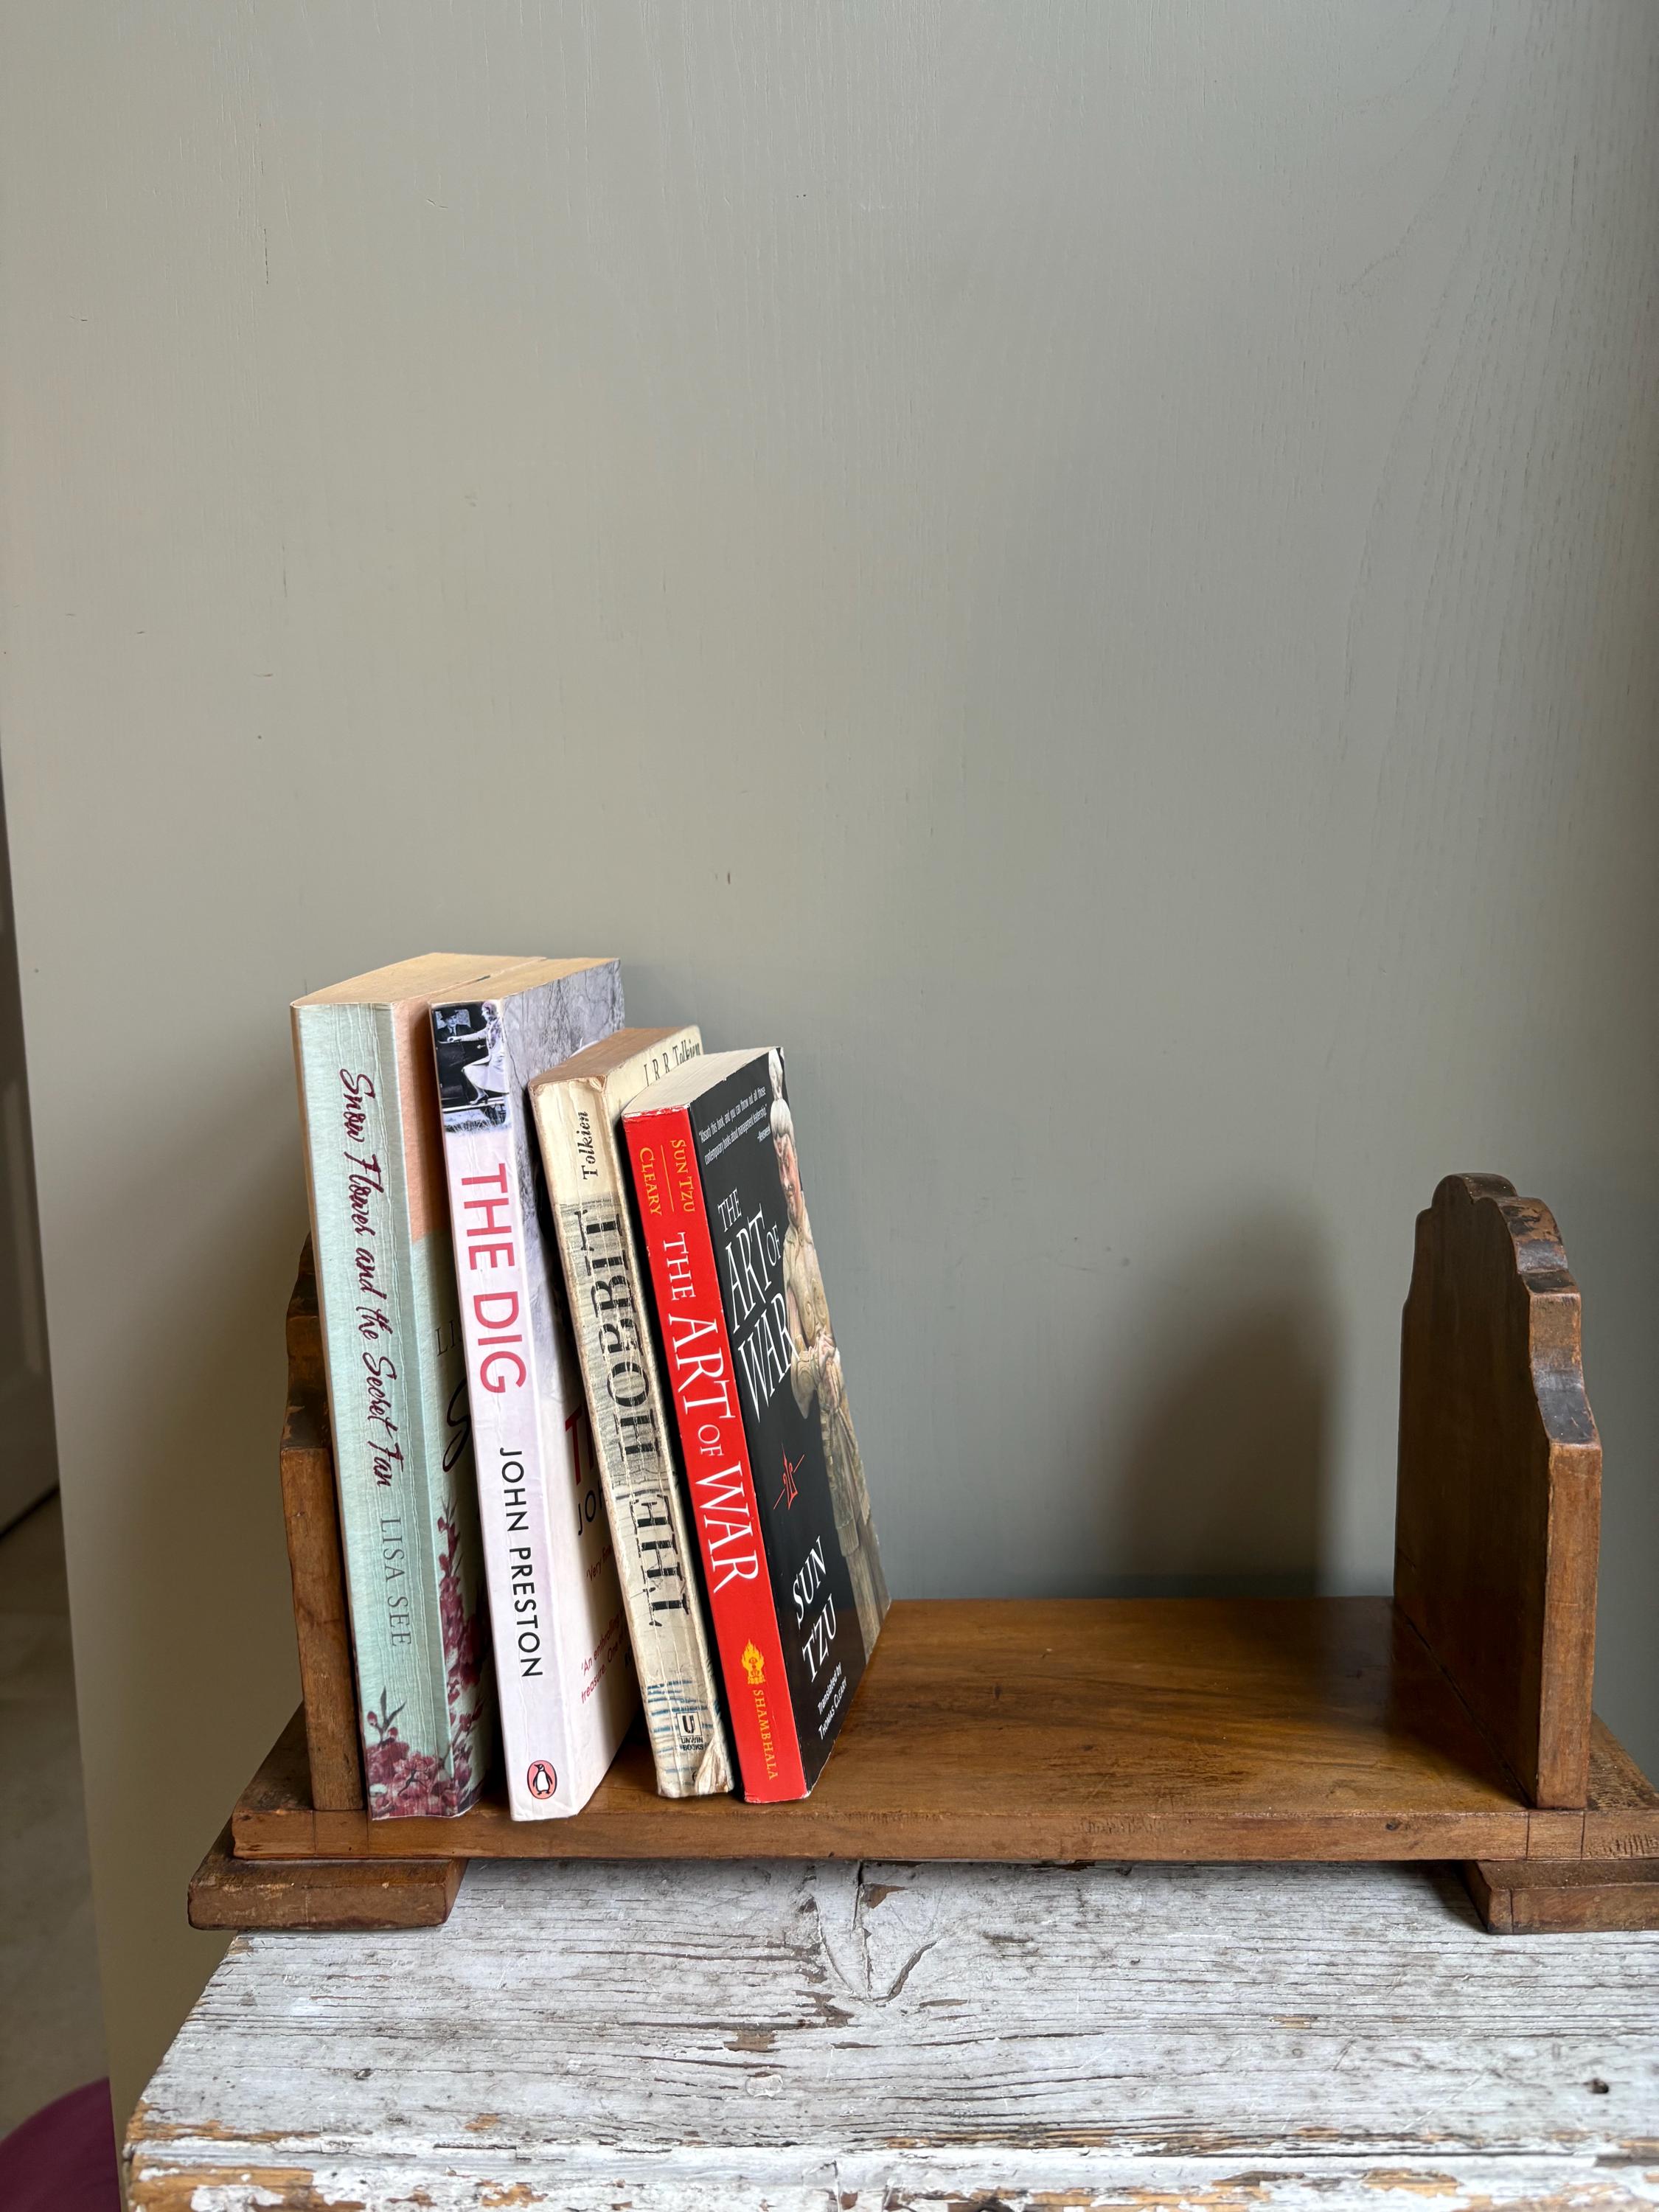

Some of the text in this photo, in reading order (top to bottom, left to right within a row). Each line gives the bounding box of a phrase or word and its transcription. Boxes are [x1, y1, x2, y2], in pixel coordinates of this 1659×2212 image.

[653, 1059, 660, 1081] R
[663, 1052, 669, 1074] R
[672, 1039, 700, 1066] Tolkien
[578, 1111, 598, 1180] Tolkien
[639, 1147, 662, 1217] CLEARY
[671, 1139, 695, 1212] SUN TZU
[717, 1188, 742, 1234] THE
[340, 1068, 403, 1487] Snow Flower and the Secret Fan
[462, 1164, 526, 1393] THE DIG
[725, 1203, 782, 1334] ART OF
[737, 1292, 799, 1422] WAR
[574, 1209, 689, 1627] THE HOBBIT
[663, 1231, 759, 1593] THE ART OF WAR
[380, 1517, 411, 1646] LISA SEE
[501, 1447, 543, 1677] JOHN PRESTON
[793, 1536, 827, 1630] SUN
[801, 1593, 837, 1683] TZU
[753, 1689, 779, 1781] SHAMBHALA
[818, 1661, 841, 1715] Translated by
